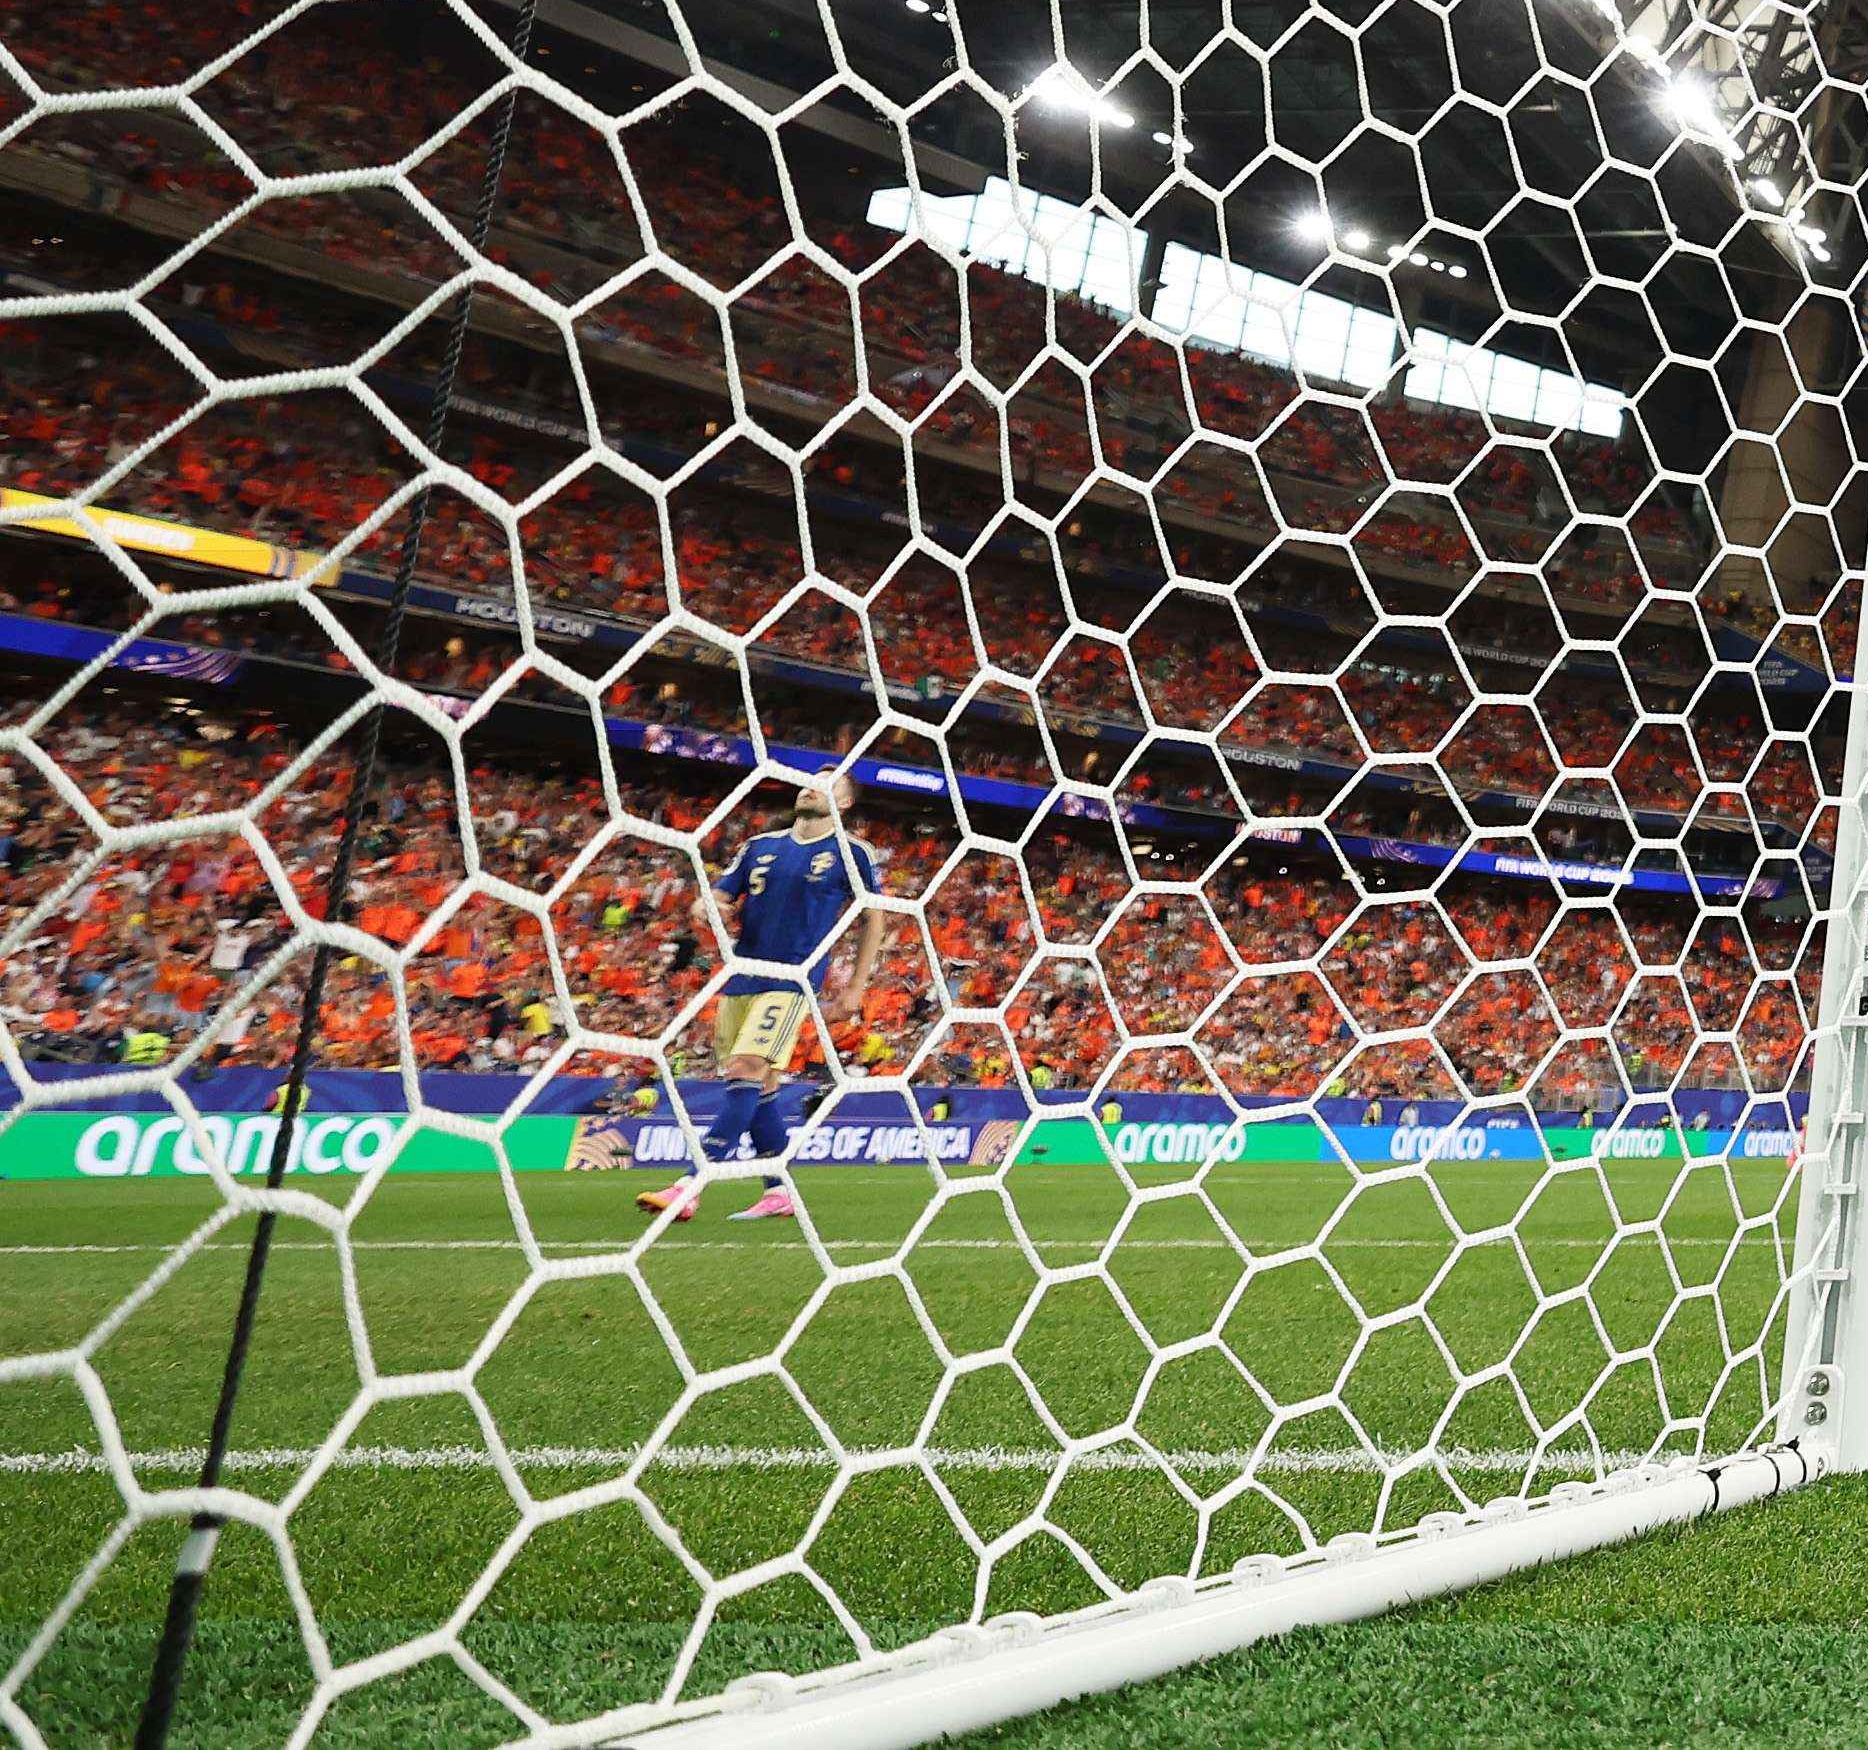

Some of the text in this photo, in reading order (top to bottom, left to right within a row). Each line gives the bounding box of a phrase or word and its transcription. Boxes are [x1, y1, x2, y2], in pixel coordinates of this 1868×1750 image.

[454, 598, 596, 639] HOUTON
[748, 866, 771, 896] 5
[759, 1005, 784, 1031] 5
[75, 1116, 395, 1176] aramco
[831, 1127, 871, 1160] OF
[1114, 1123, 1247, 1162] aramco
